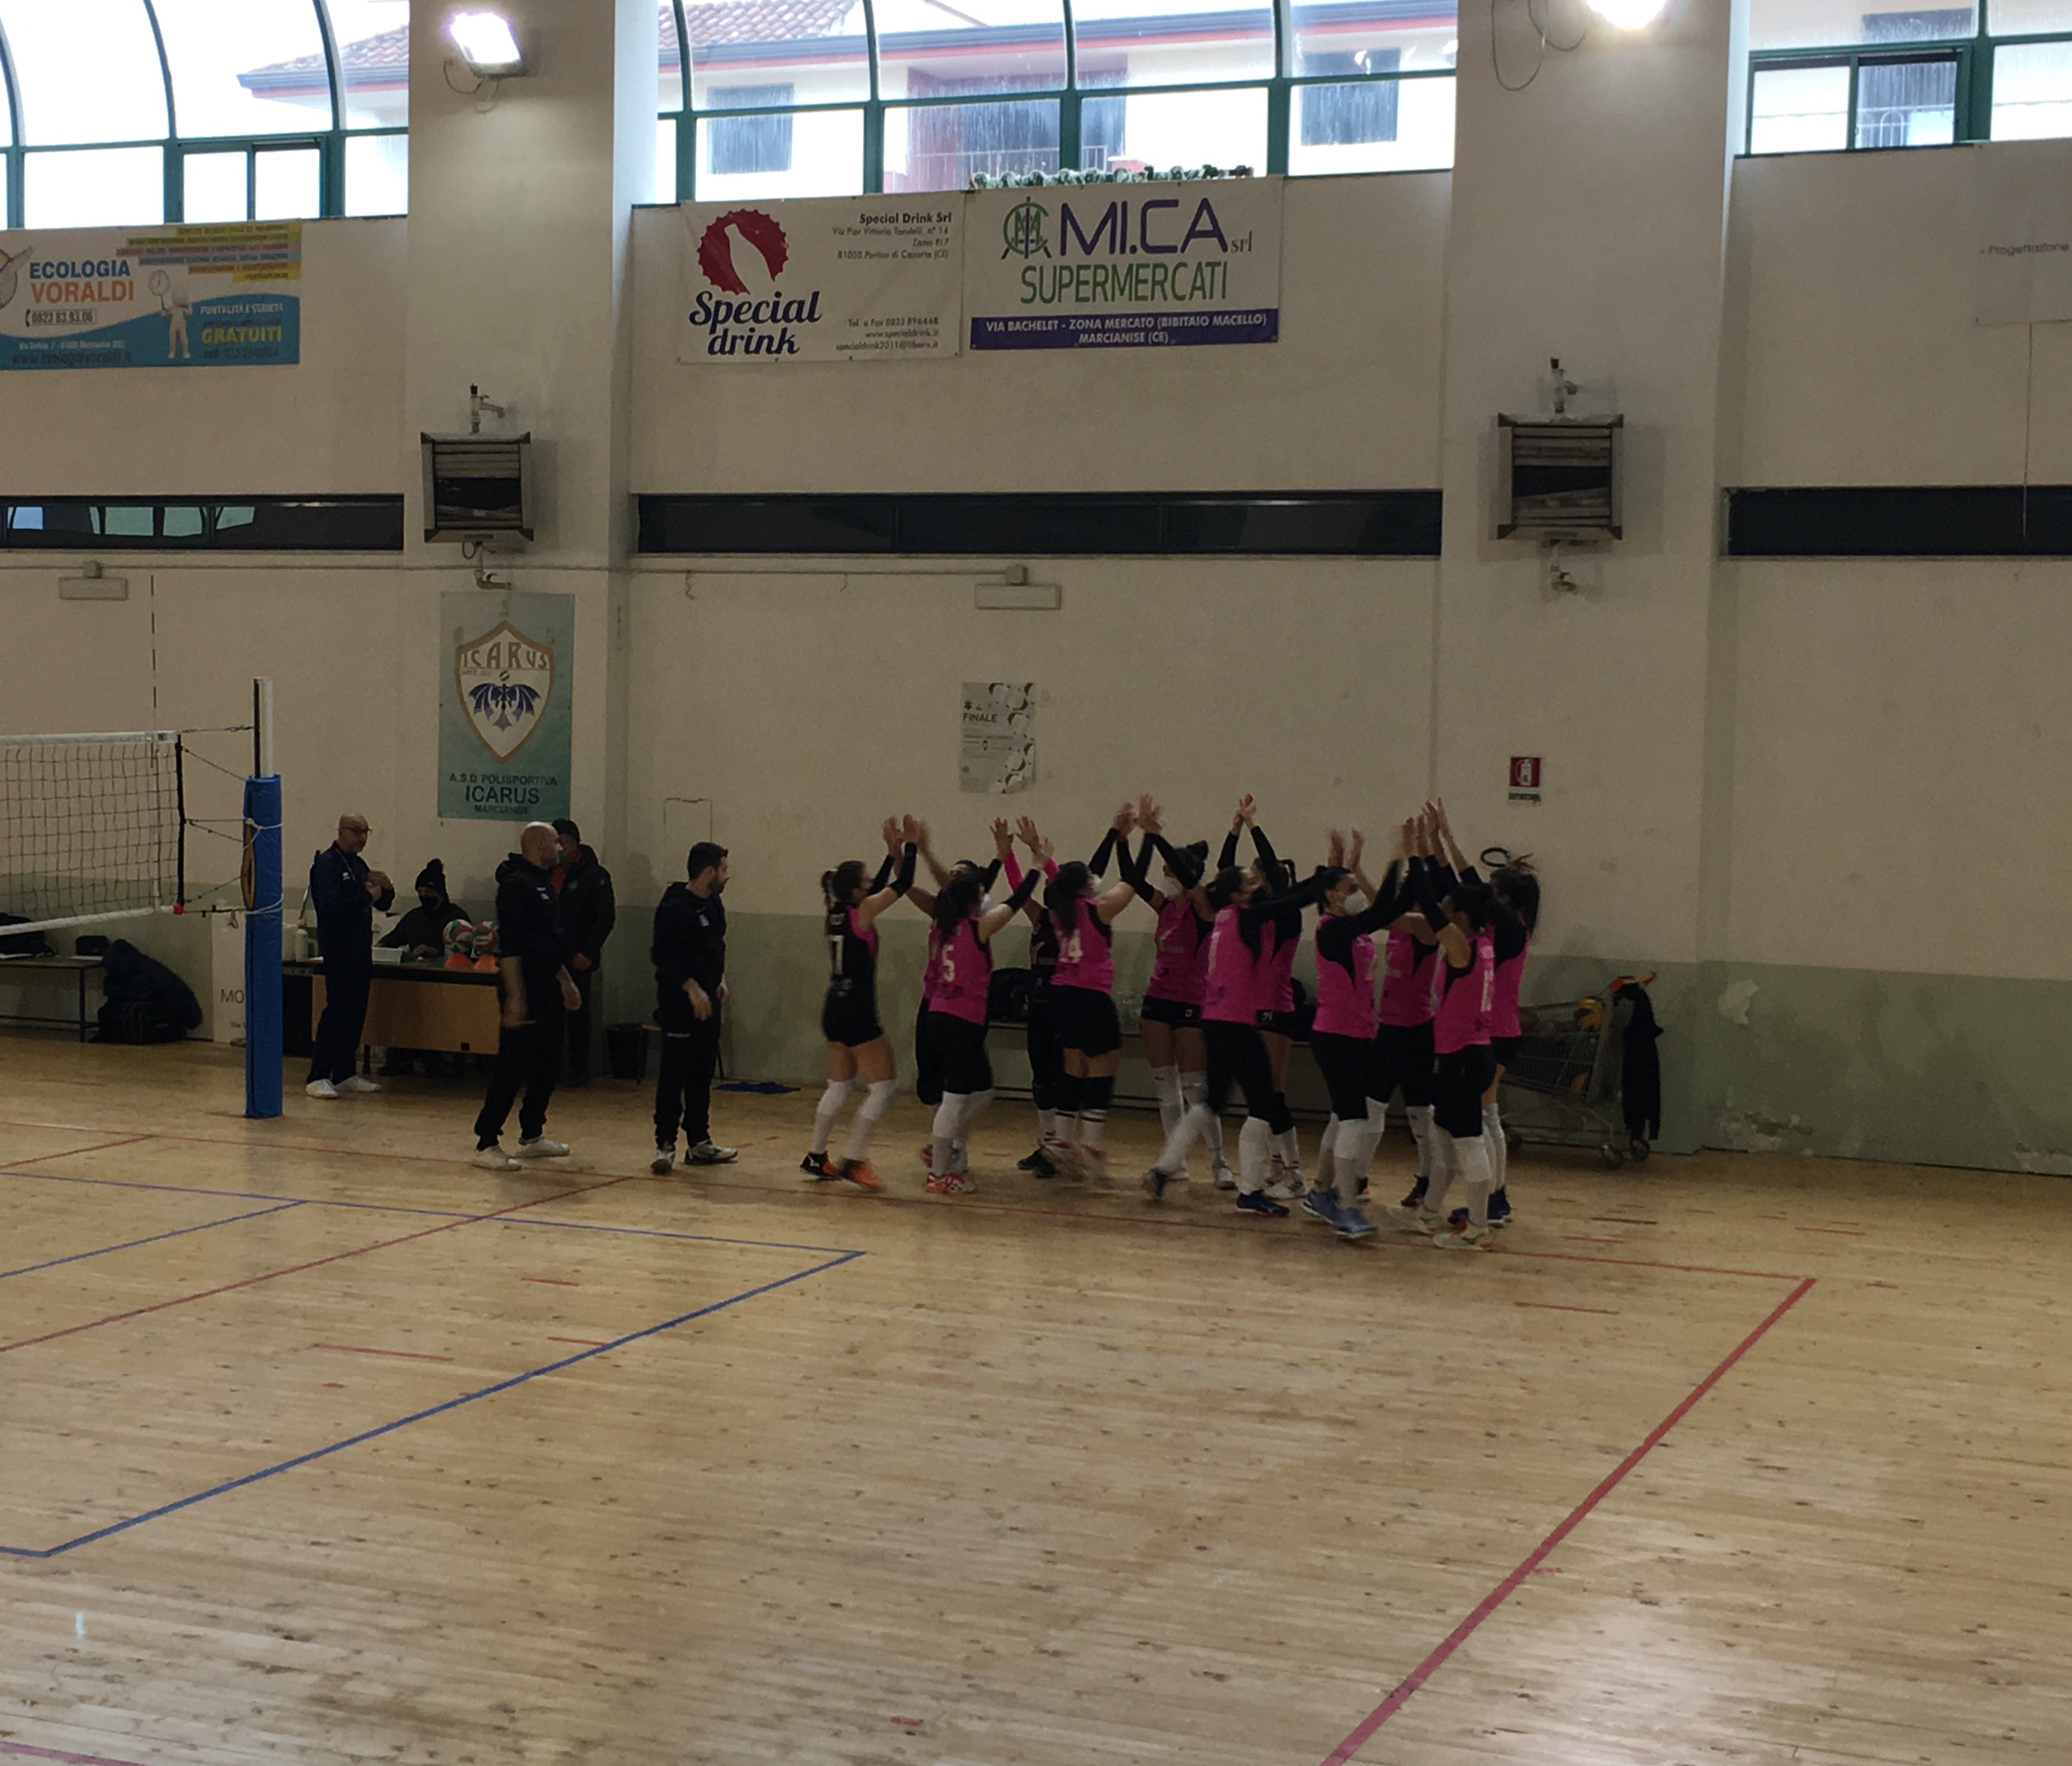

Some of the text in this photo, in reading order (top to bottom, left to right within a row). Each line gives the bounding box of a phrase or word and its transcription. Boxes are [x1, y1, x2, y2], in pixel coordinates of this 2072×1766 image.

[859, 211, 952, 226] Special Drink Srl
[1060, 197, 1228, 256] MI.CA
[832, 227, 845, 236] Via
[939, 226, 949, 235] 14
[913, 238, 933, 247] Zona
[1231, 231, 1253, 253] srl
[1989, 243, 2070, 256] Progettazione
[892, 250, 899, 258] di
[29, 259, 130, 279] ECOLOGIA
[31, 280, 134, 304] VORALDI
[1020, 261, 1228, 305] SUPERMERCATI
[689, 291, 823, 335] Special
[986, 321, 1006, 332] VIA
[1008, 319, 1059, 331] BACHELET
[1069, 318, 1102, 330] ZONA
[1104, 316, 1155, 329] MERCATO
[1212, 312, 1267, 327] MACELLO)
[201, 326, 282, 344] GRATUITI
[707, 327, 800, 355] drink
[1078, 330, 1169, 345] MARCIANISE (CE)
[464, 641, 548, 669] ICARUS
[963, 713, 998, 723] FINALE
[465, 785, 540, 804] ICARUS
